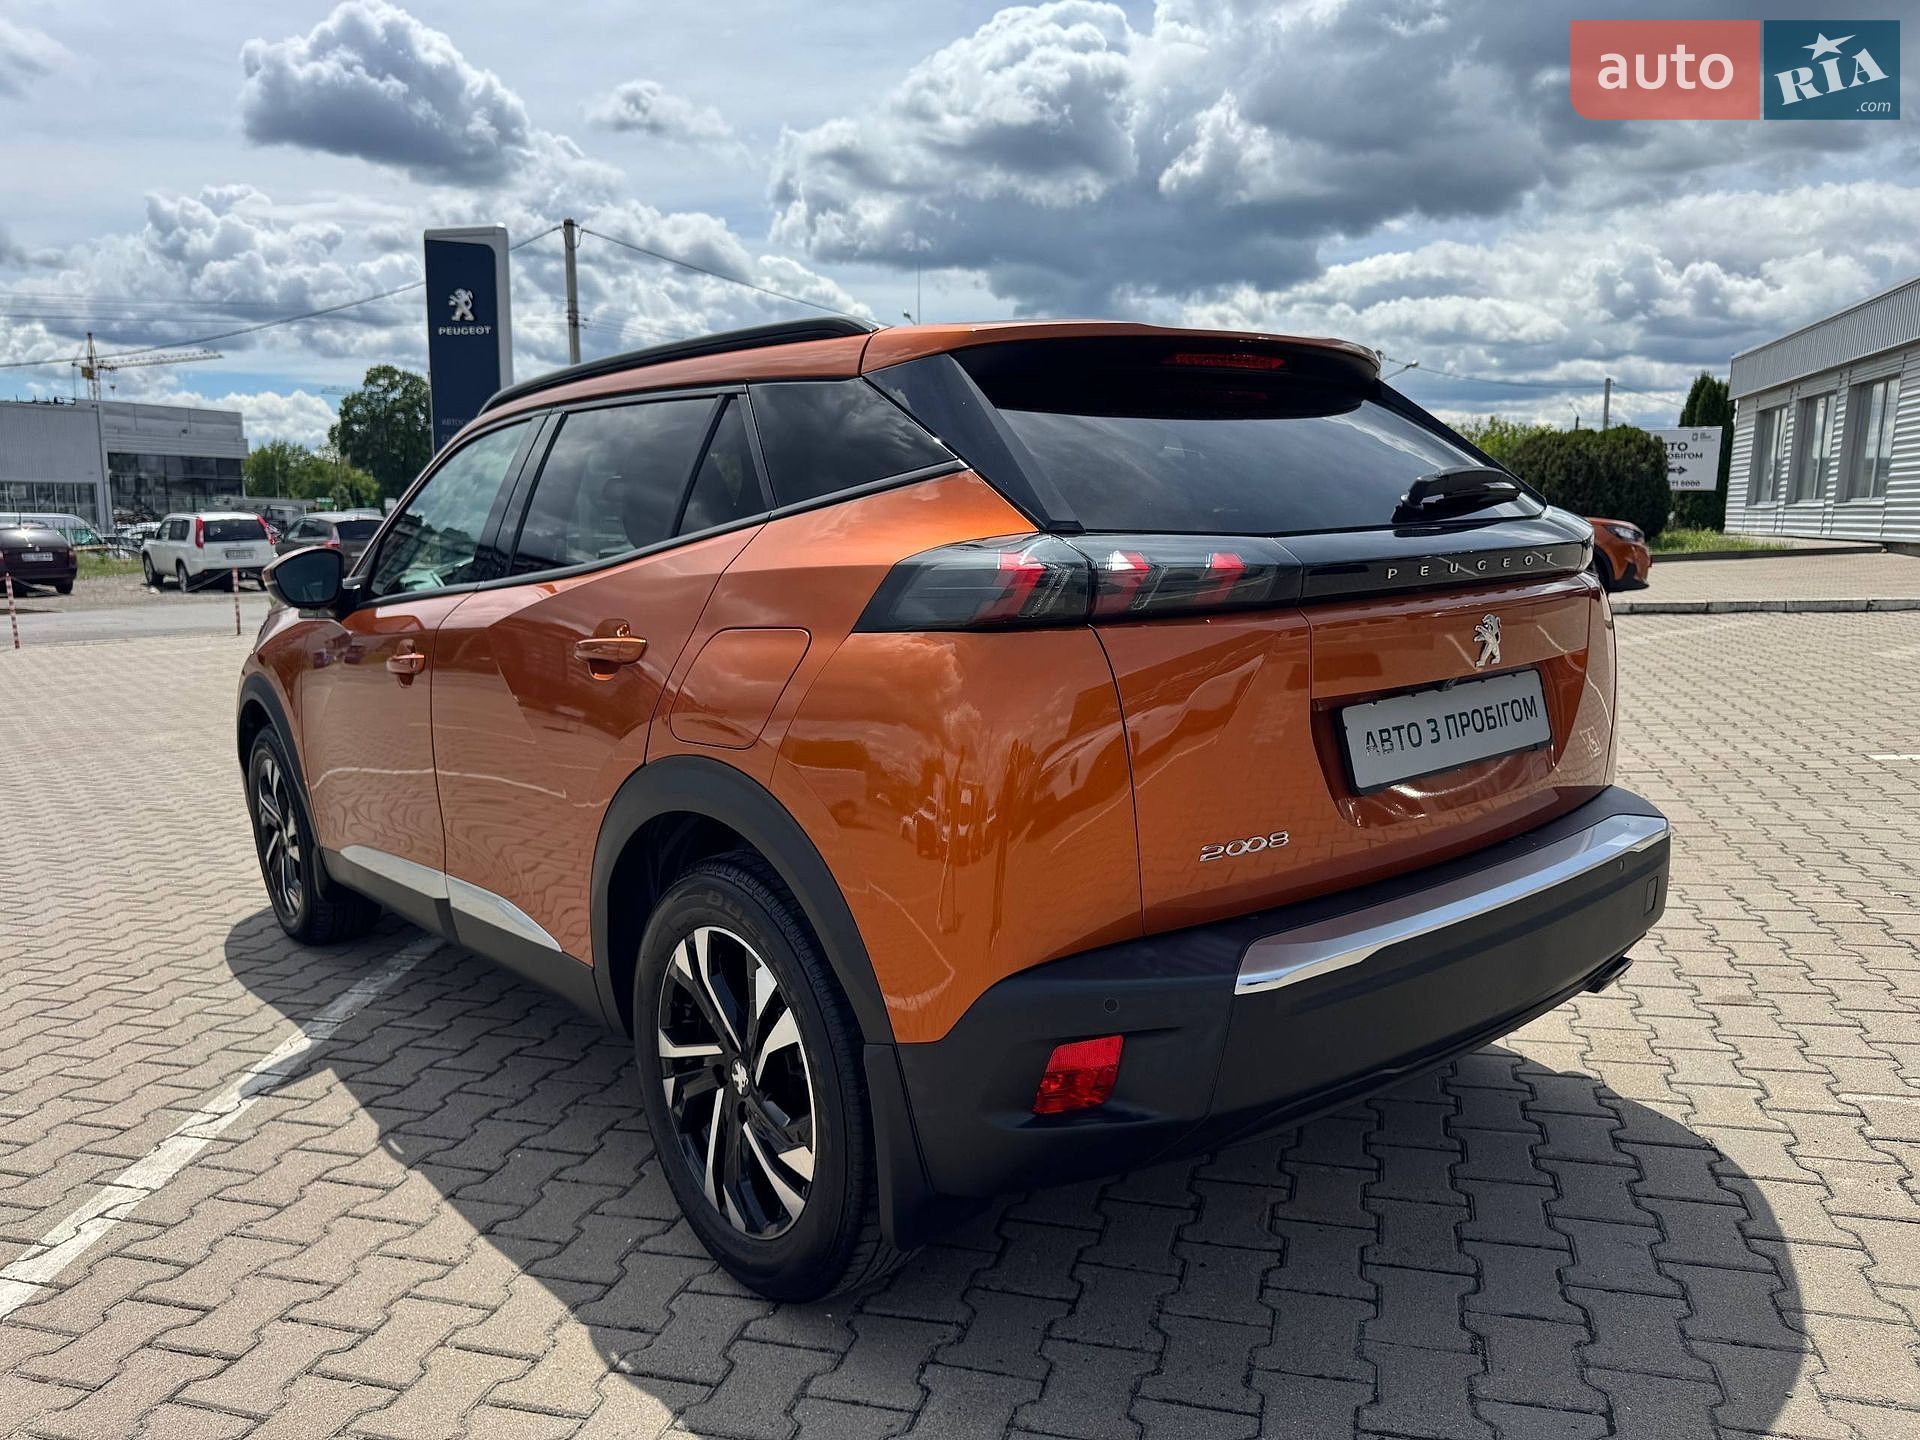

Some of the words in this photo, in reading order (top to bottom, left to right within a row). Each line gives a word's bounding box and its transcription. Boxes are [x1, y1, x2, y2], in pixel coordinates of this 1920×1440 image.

[438, 326, 492, 336] PEUGEOT
[1666, 452, 1704, 460] ОБІГОМ
[1387, 552, 1553, 580] PEUGEOT
[1365, 721, 1423, 756] АВТО
[1444, 695, 1539, 741] ПРОБІГОМ
[1199, 830, 1290, 862] 2008
